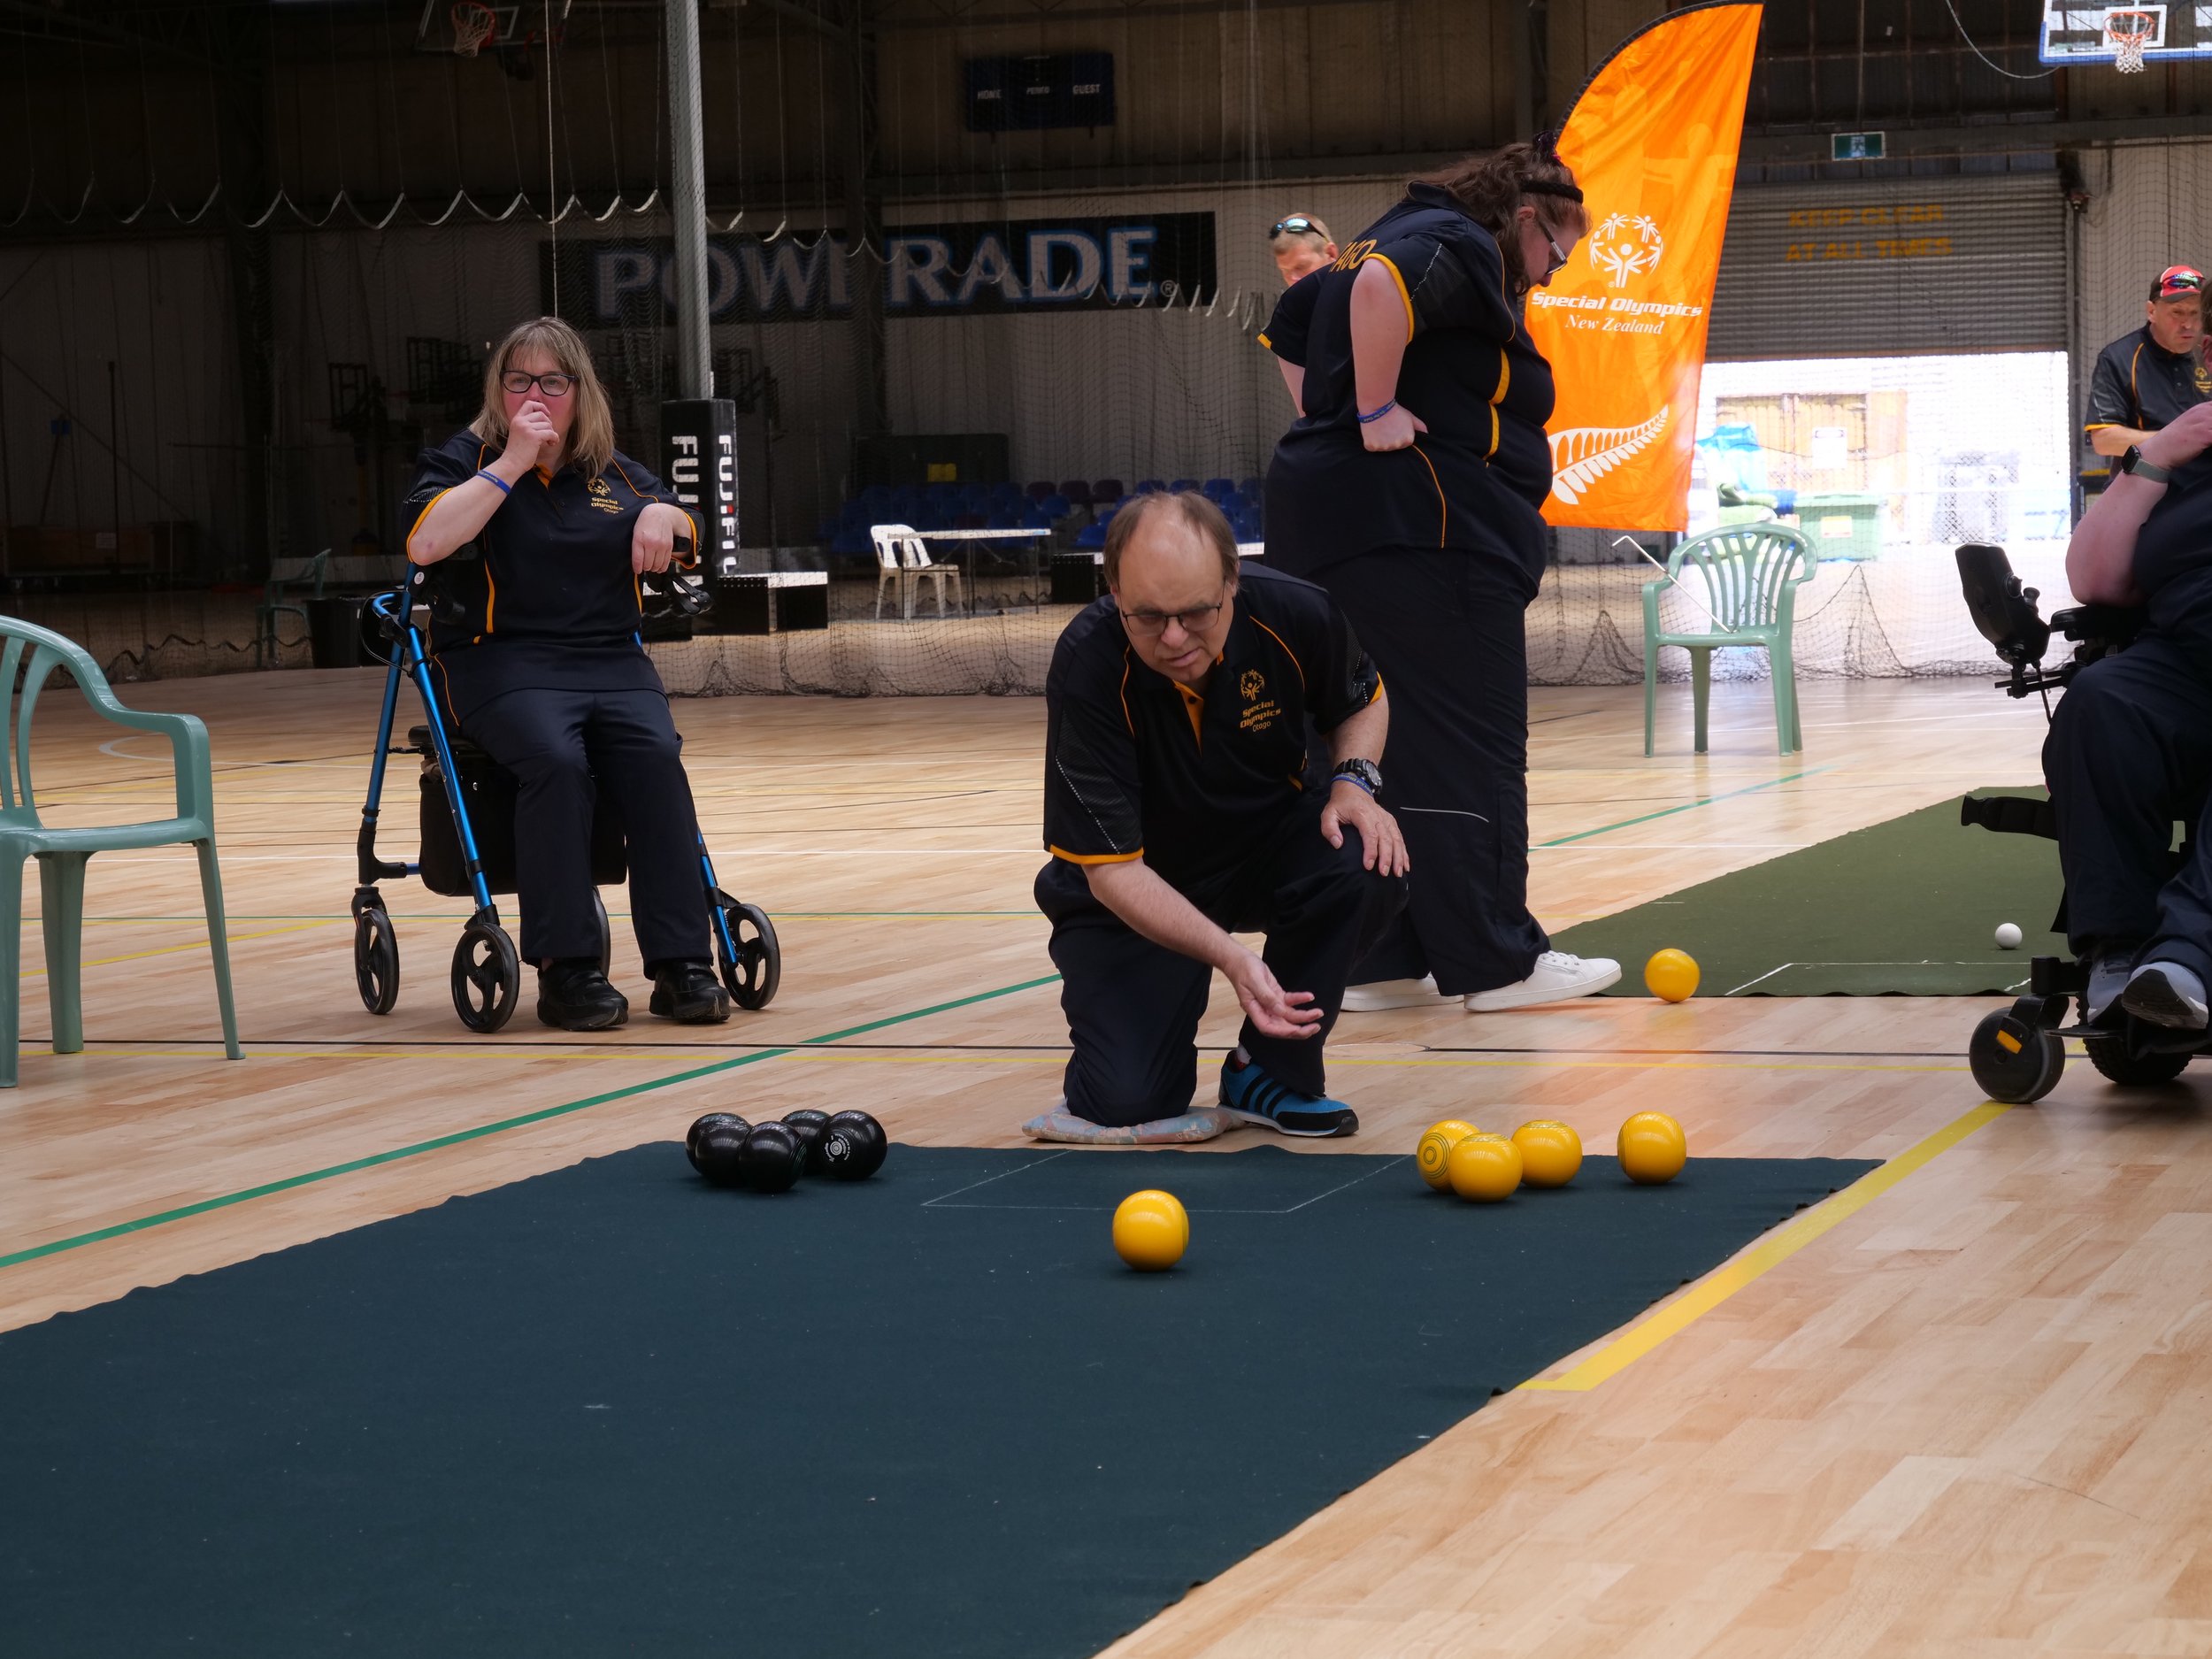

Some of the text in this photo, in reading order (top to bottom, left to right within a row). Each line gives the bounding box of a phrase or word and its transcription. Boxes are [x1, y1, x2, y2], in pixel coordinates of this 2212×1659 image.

[1072, 83, 1101, 95] GUEST
[1789, 204, 1944, 227] KEEP CLEAR
[1786, 237, 1954, 262] AT ALL TIMES
[1532, 291, 1703, 317] Special Olympics
[1565, 314, 1665, 335] New Zealand
[718, 435, 737, 574] FUJIFIL
[1240, 708, 1282, 728] Olympics
[1242, 700, 1274, 718] Special
[1252, 720, 1271, 733] Otago
